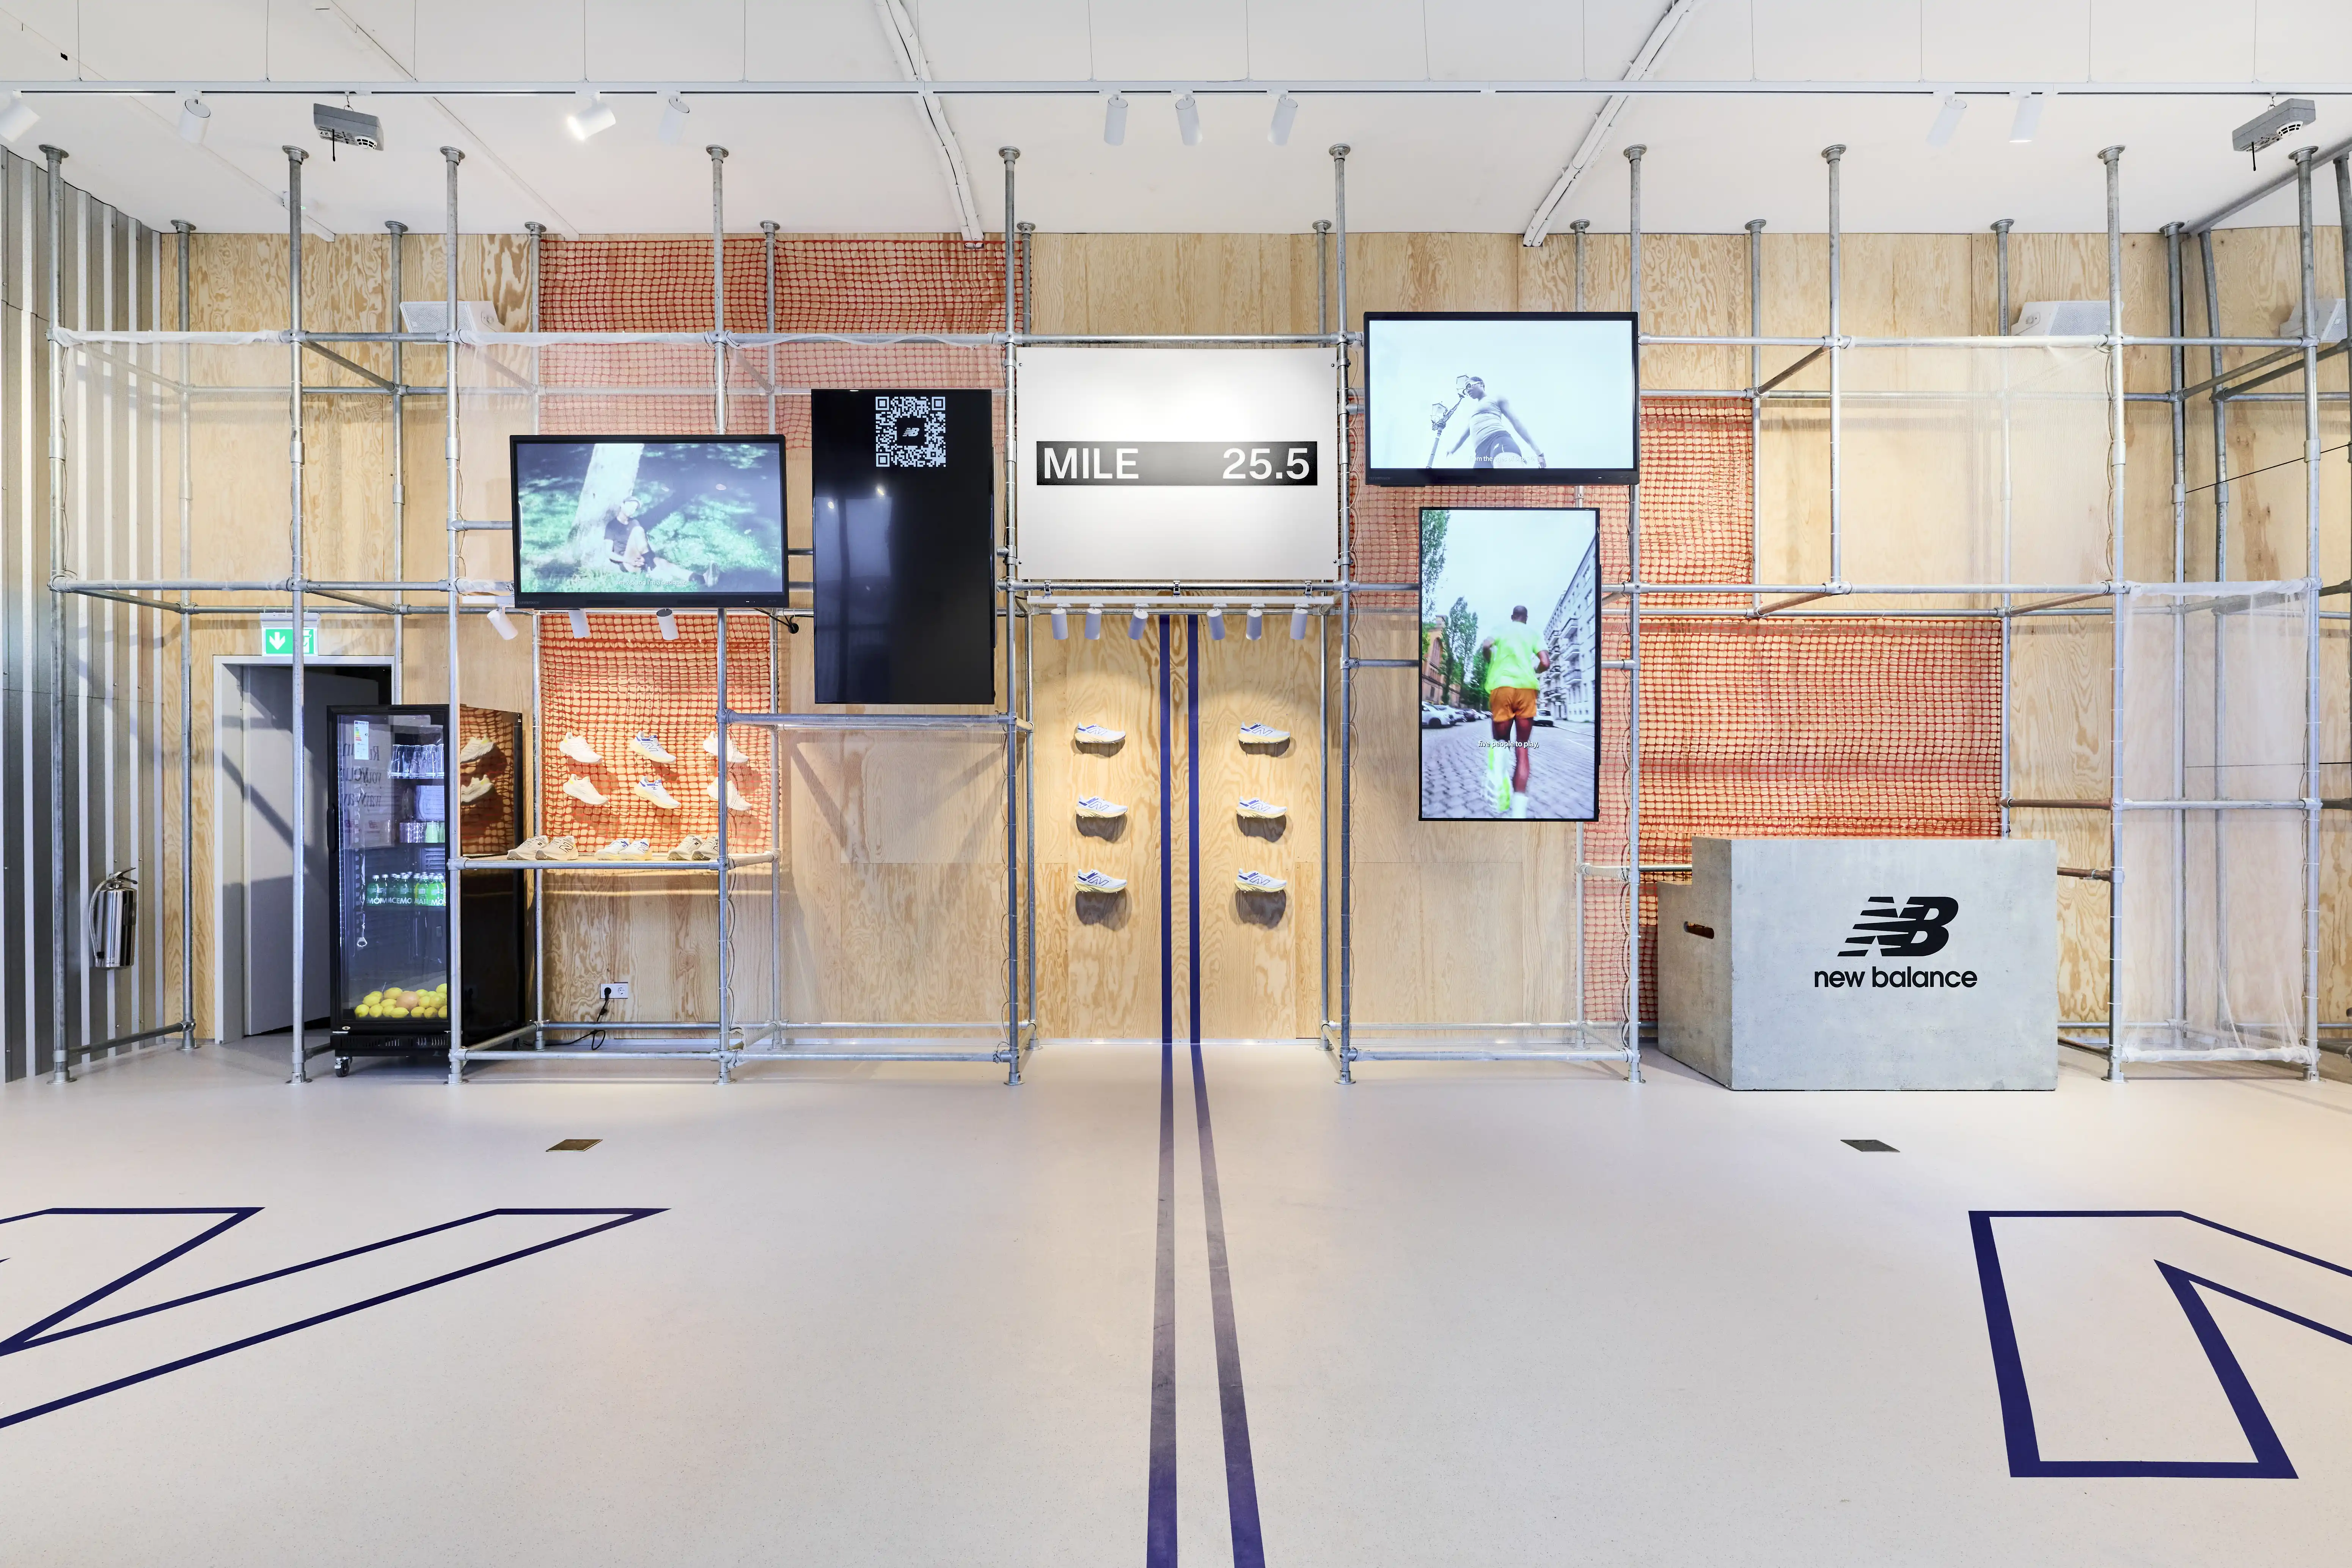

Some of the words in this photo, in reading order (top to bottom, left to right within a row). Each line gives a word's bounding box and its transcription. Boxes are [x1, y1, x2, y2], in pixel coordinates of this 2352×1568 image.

[1044, 448, 1139, 479] MILE
[1222, 448, 1309, 479] 25.5
[1491, 740, 1515, 749] people
[1524, 740, 1540, 749] play,
[1837, 896, 1959, 957] NB
[1815, 970, 1865, 988] new
[1872, 966, 1978, 988] balance
